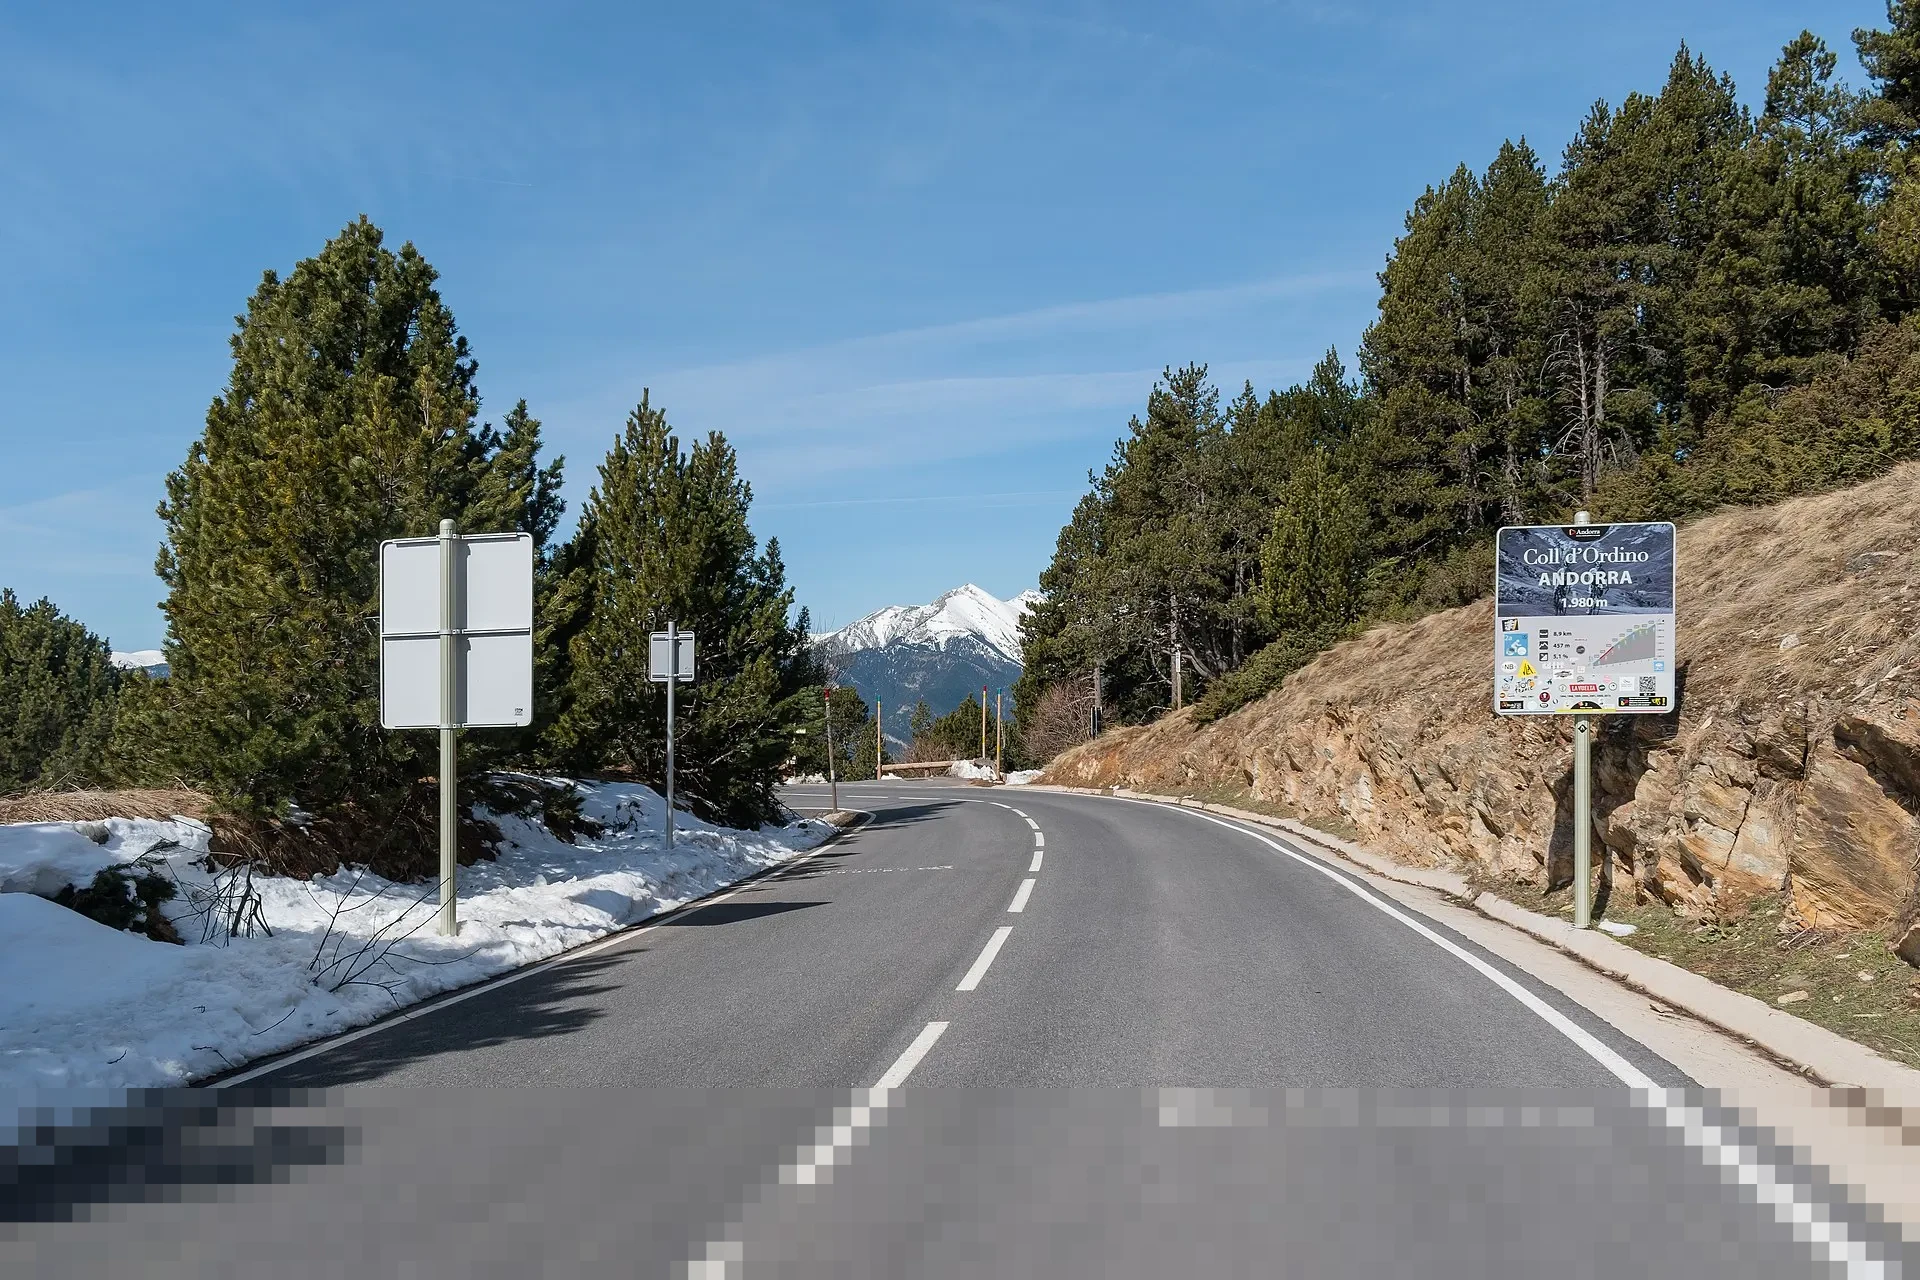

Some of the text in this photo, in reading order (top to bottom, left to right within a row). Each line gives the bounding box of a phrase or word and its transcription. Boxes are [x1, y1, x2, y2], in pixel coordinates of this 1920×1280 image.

[1523, 547, 1559, 565] Coll
[1538, 570, 1633, 586] ANDORRA
[1561, 598, 1608, 608] 1.980 m
